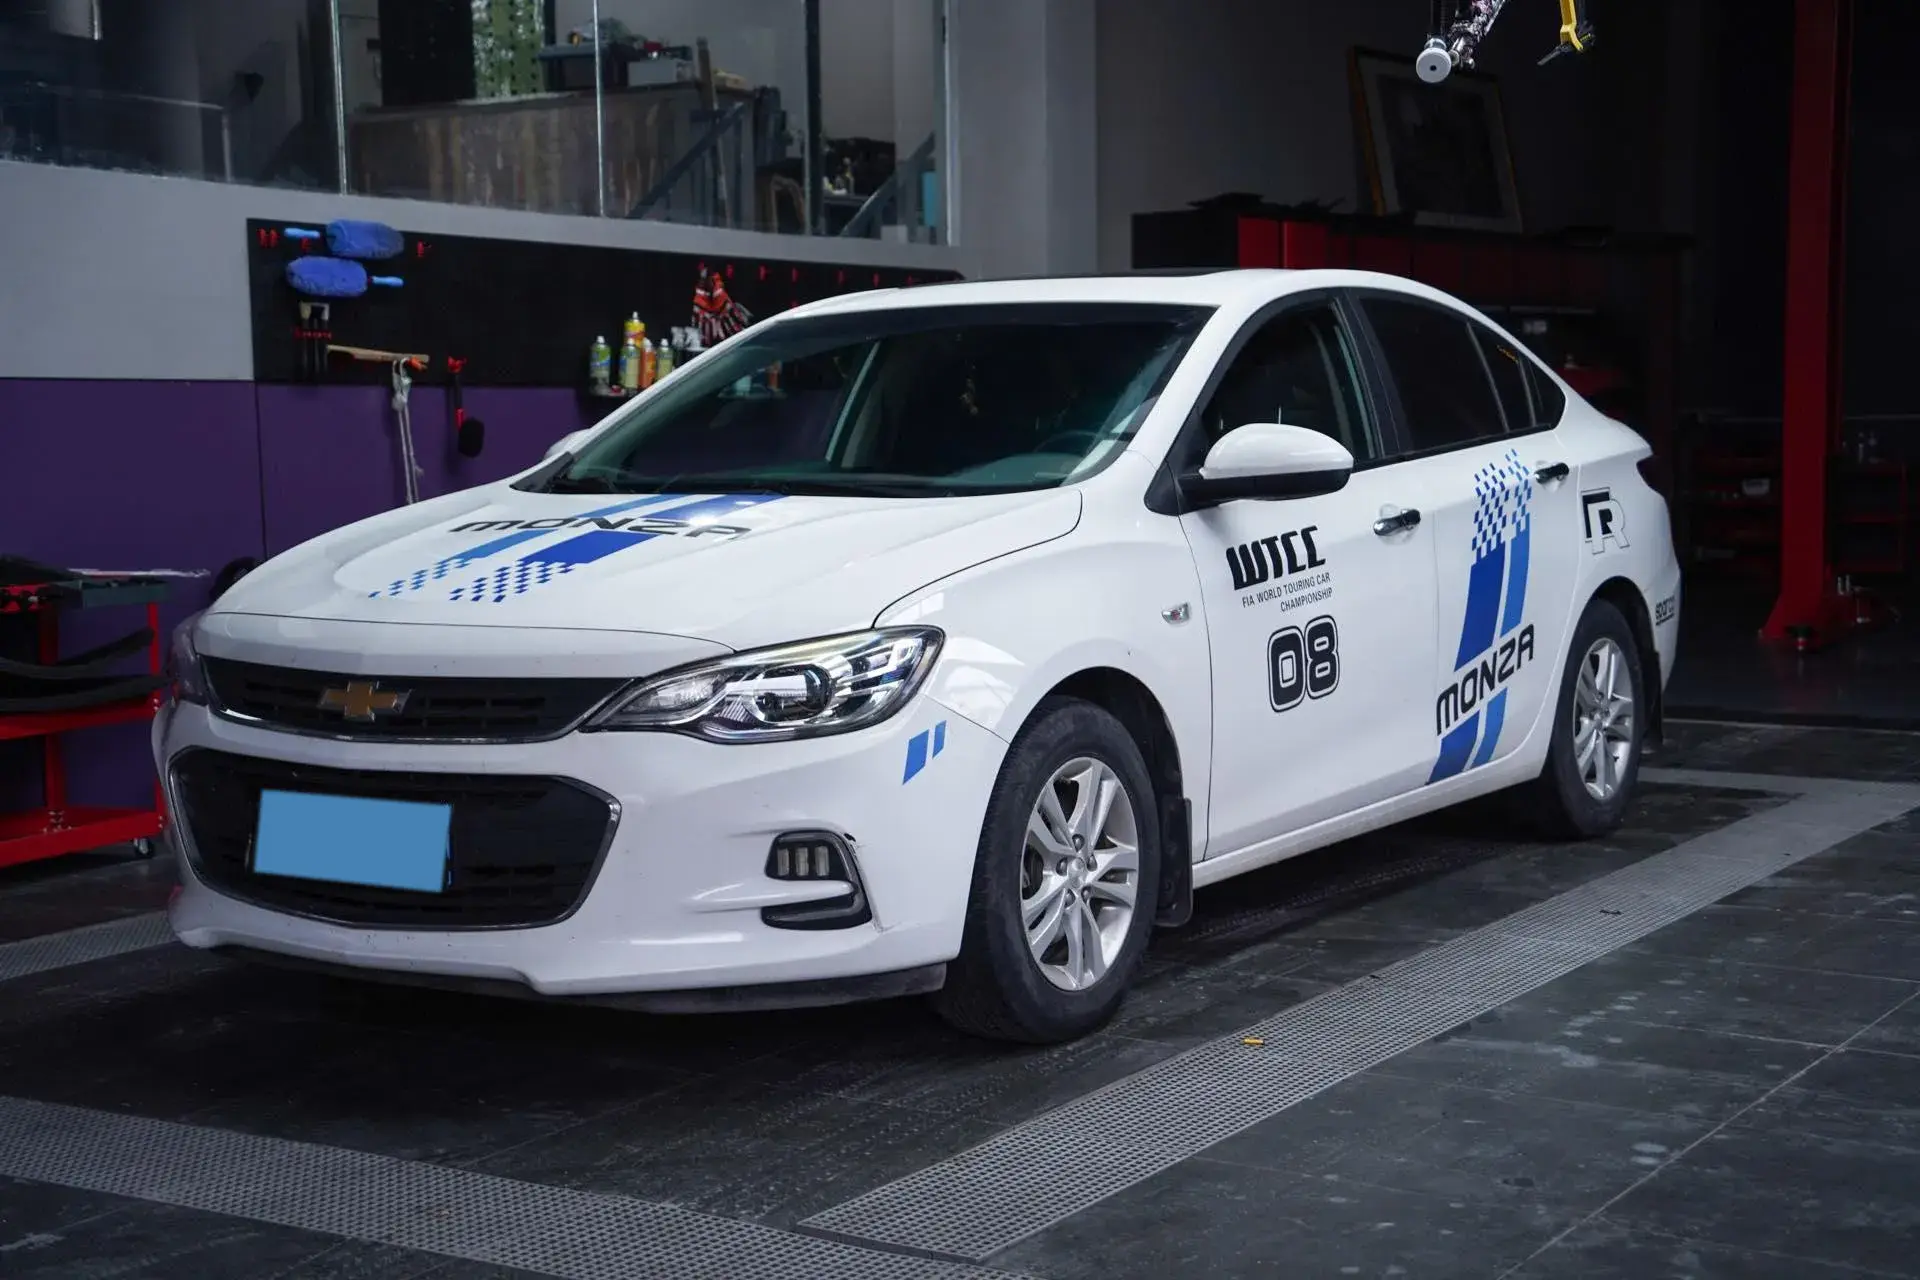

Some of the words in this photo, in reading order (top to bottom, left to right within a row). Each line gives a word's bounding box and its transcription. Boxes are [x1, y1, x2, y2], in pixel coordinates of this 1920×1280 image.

[449, 517, 752, 541] MONZA
[1225, 525, 1326, 591] WTCC
[1242, 595, 1255, 608] FIA
[1256, 586, 1282, 604] WORLD
[1283, 576, 1316, 595] TOURING
[1316, 572, 1331, 586] CAR
[1280, 587, 1333, 612] CHAMPIONSHIP
[1267, 614, 1340, 713] 08
[1436, 624, 1535, 736] MONZA
